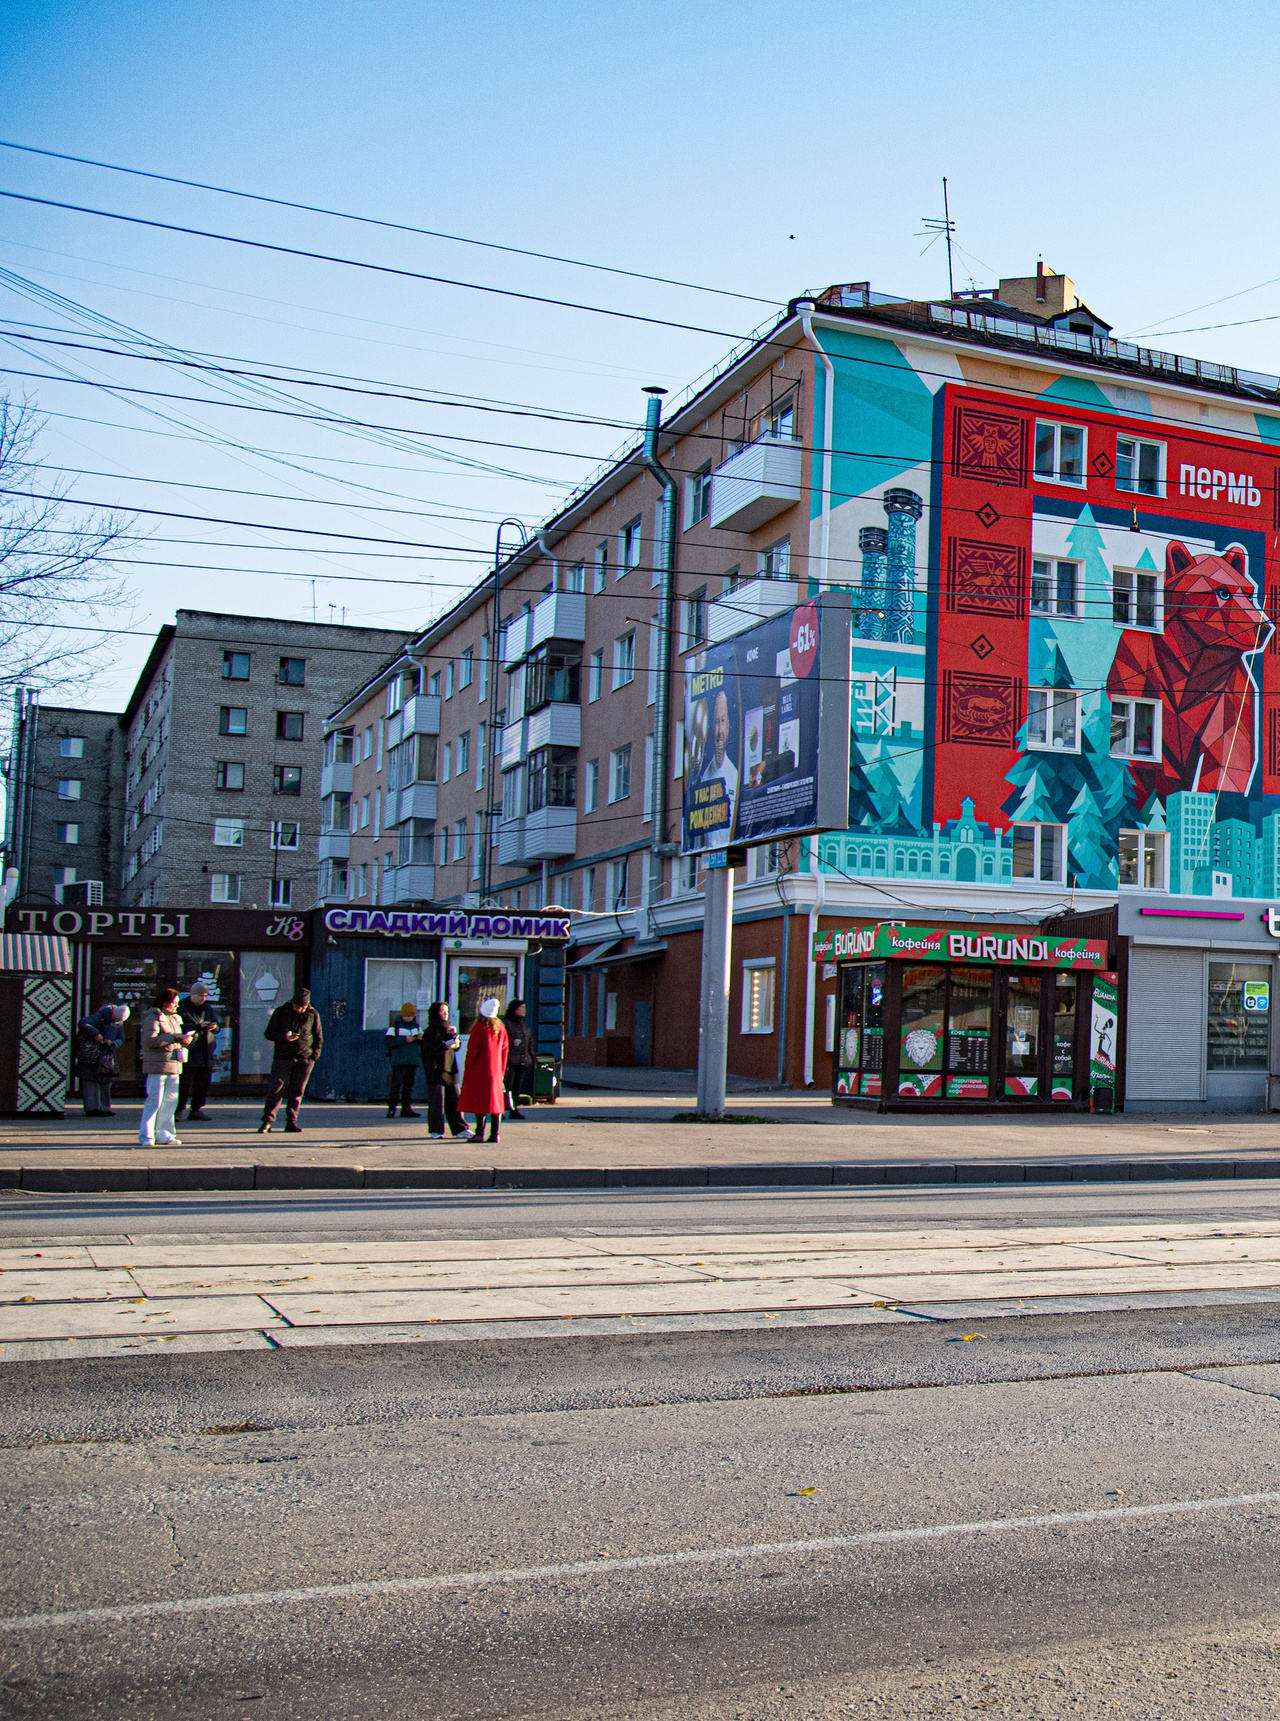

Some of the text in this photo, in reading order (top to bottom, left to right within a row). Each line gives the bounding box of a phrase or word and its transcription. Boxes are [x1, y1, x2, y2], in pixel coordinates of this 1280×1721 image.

[793, 623, 816, 653] -61%
[692, 666, 723, 697] METRO
[18, 910, 190, 937] ТОРТЫ
[325, 909, 570, 939] СЛАДКИЙ ДОМИК
[835, 931, 875, 955] BURUNDI
[892, 937, 941, 951] кофейня
[949, 935, 1049, 961] BURUNDI
[1055, 947, 1100, 960] кофейня
